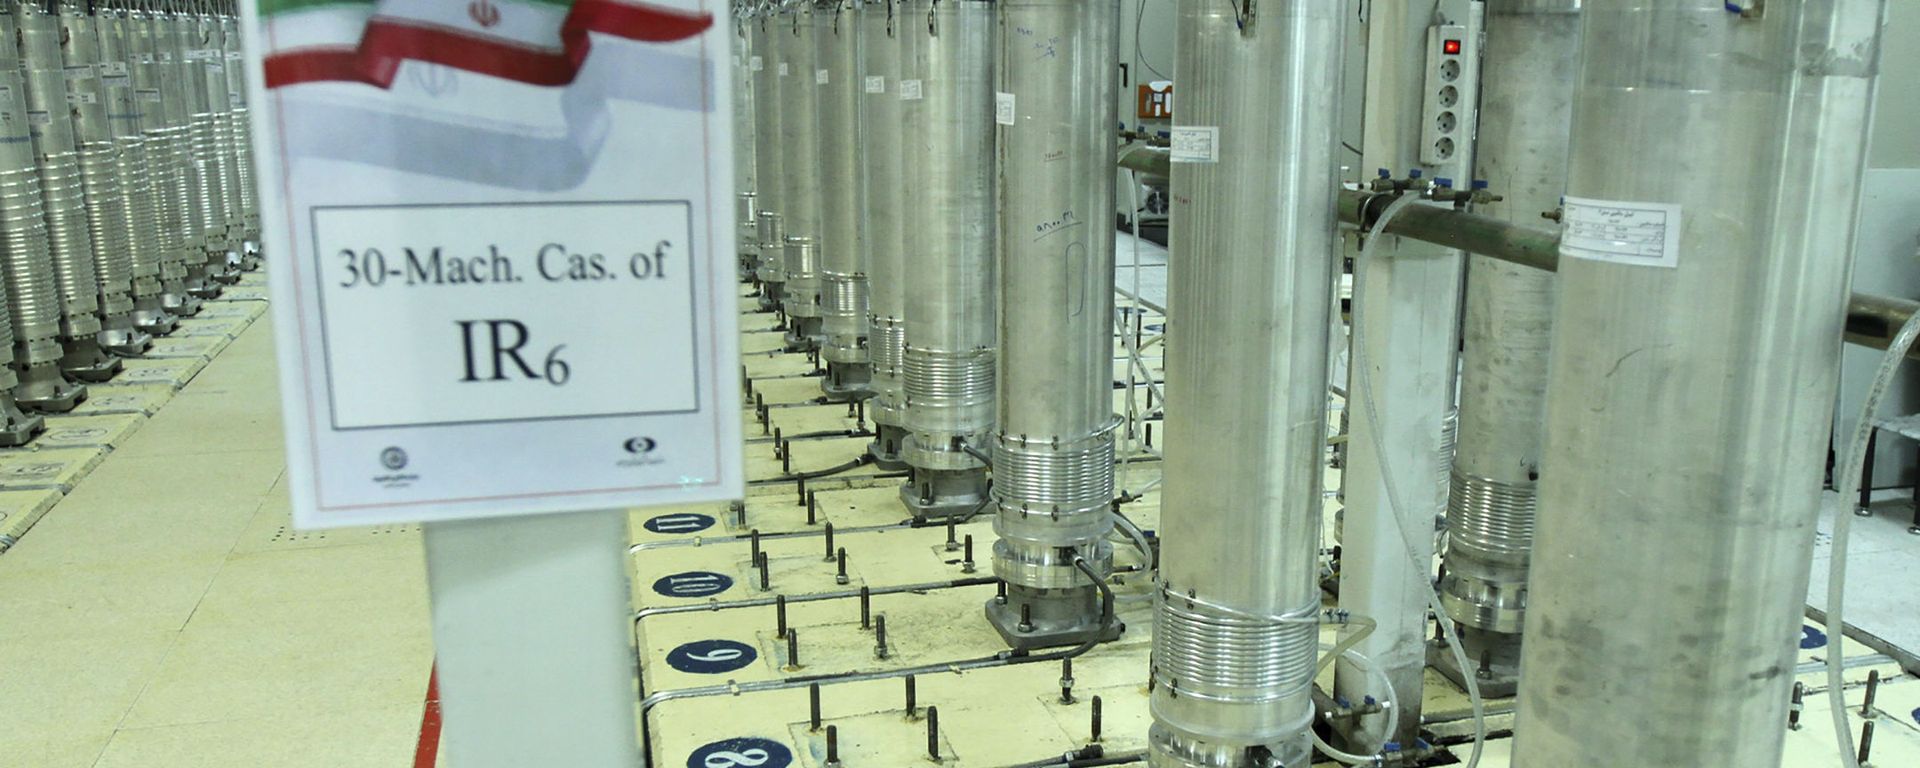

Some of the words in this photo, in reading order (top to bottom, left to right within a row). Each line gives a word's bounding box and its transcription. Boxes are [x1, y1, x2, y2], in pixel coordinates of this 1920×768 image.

[338, 245, 522, 288] 30-Mach.
[537, 242, 617, 282] Cas.
[629, 240, 672, 280] of
[655, 515, 701, 532] 11
[669, 574, 721, 593] 10
[686, 648, 742, 662] 9
[704, 748, 769, 768] 8
